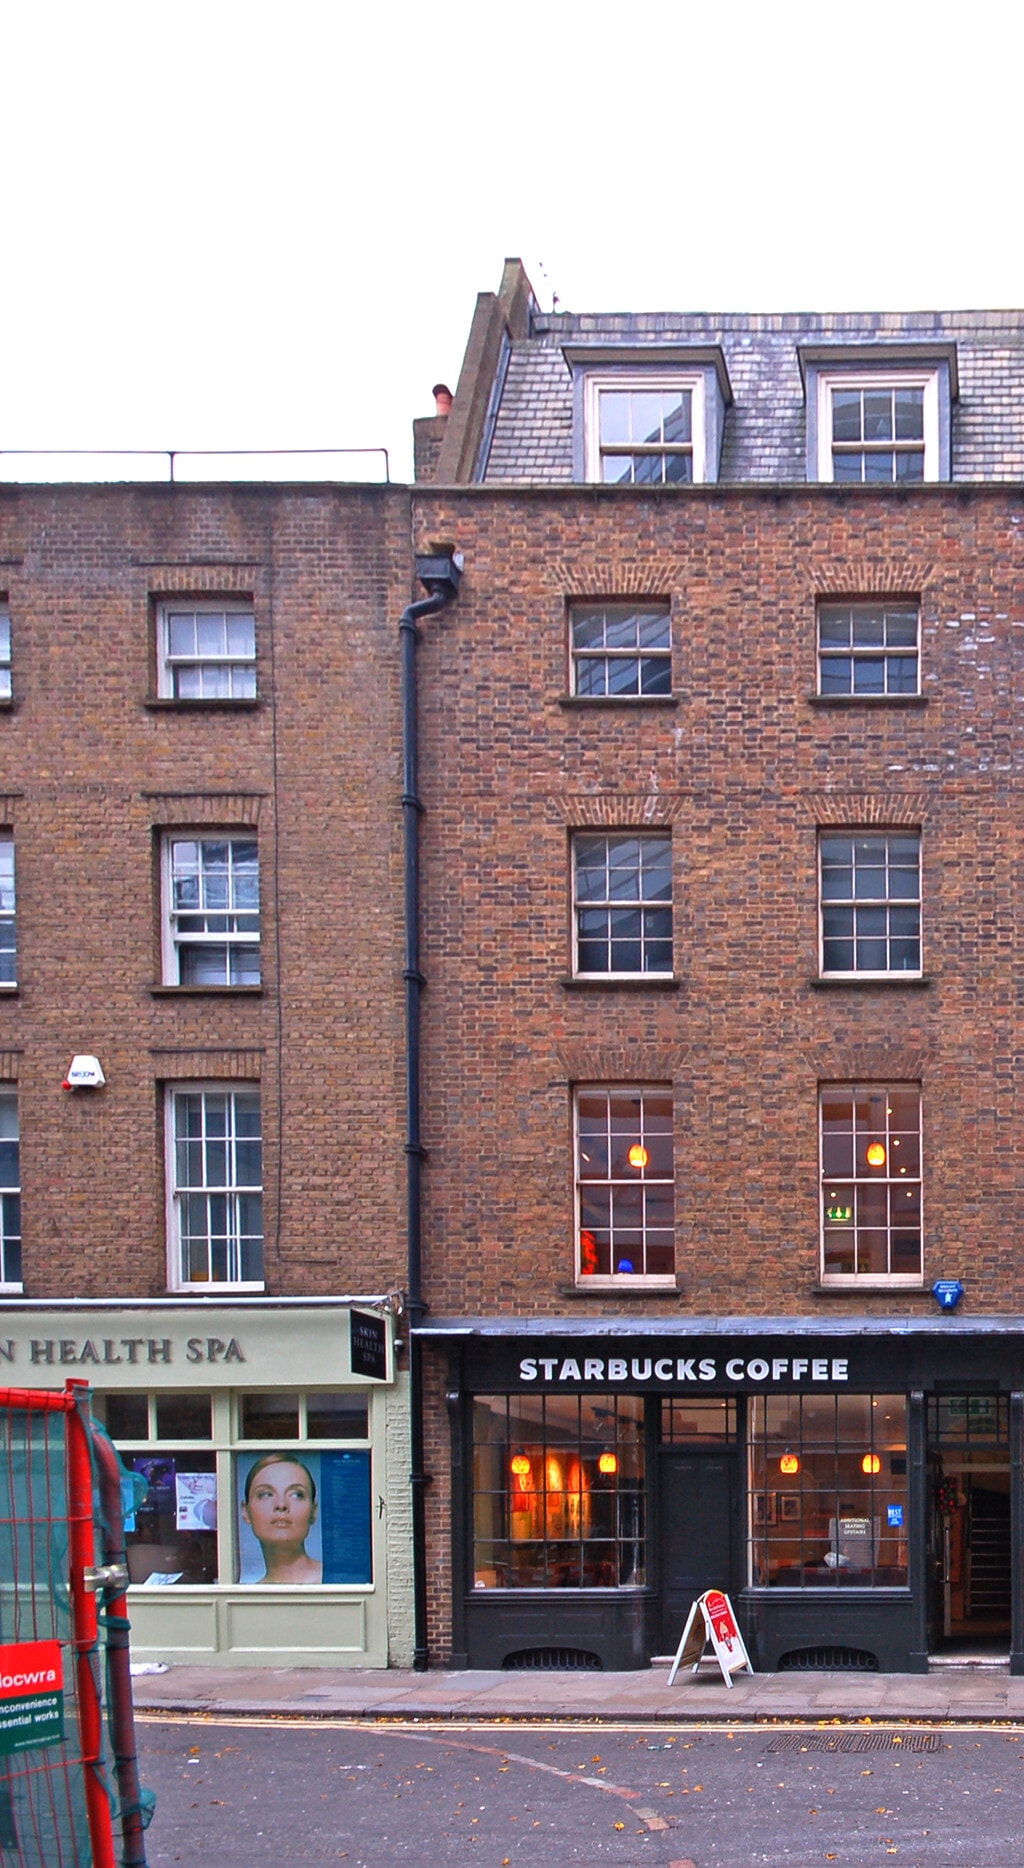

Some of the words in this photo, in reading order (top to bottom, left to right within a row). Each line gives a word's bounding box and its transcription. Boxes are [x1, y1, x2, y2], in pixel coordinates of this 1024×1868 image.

[30, 1338, 173, 1364] HEALTH
[186, 1337, 246, 1363] SPA
[353, 1336, 384, 1353] HEALTH
[519, 1358, 717, 1381] STARBUCKS
[725, 1358, 849, 1381] COFFEE
[34, 1710, 59, 1722] works
